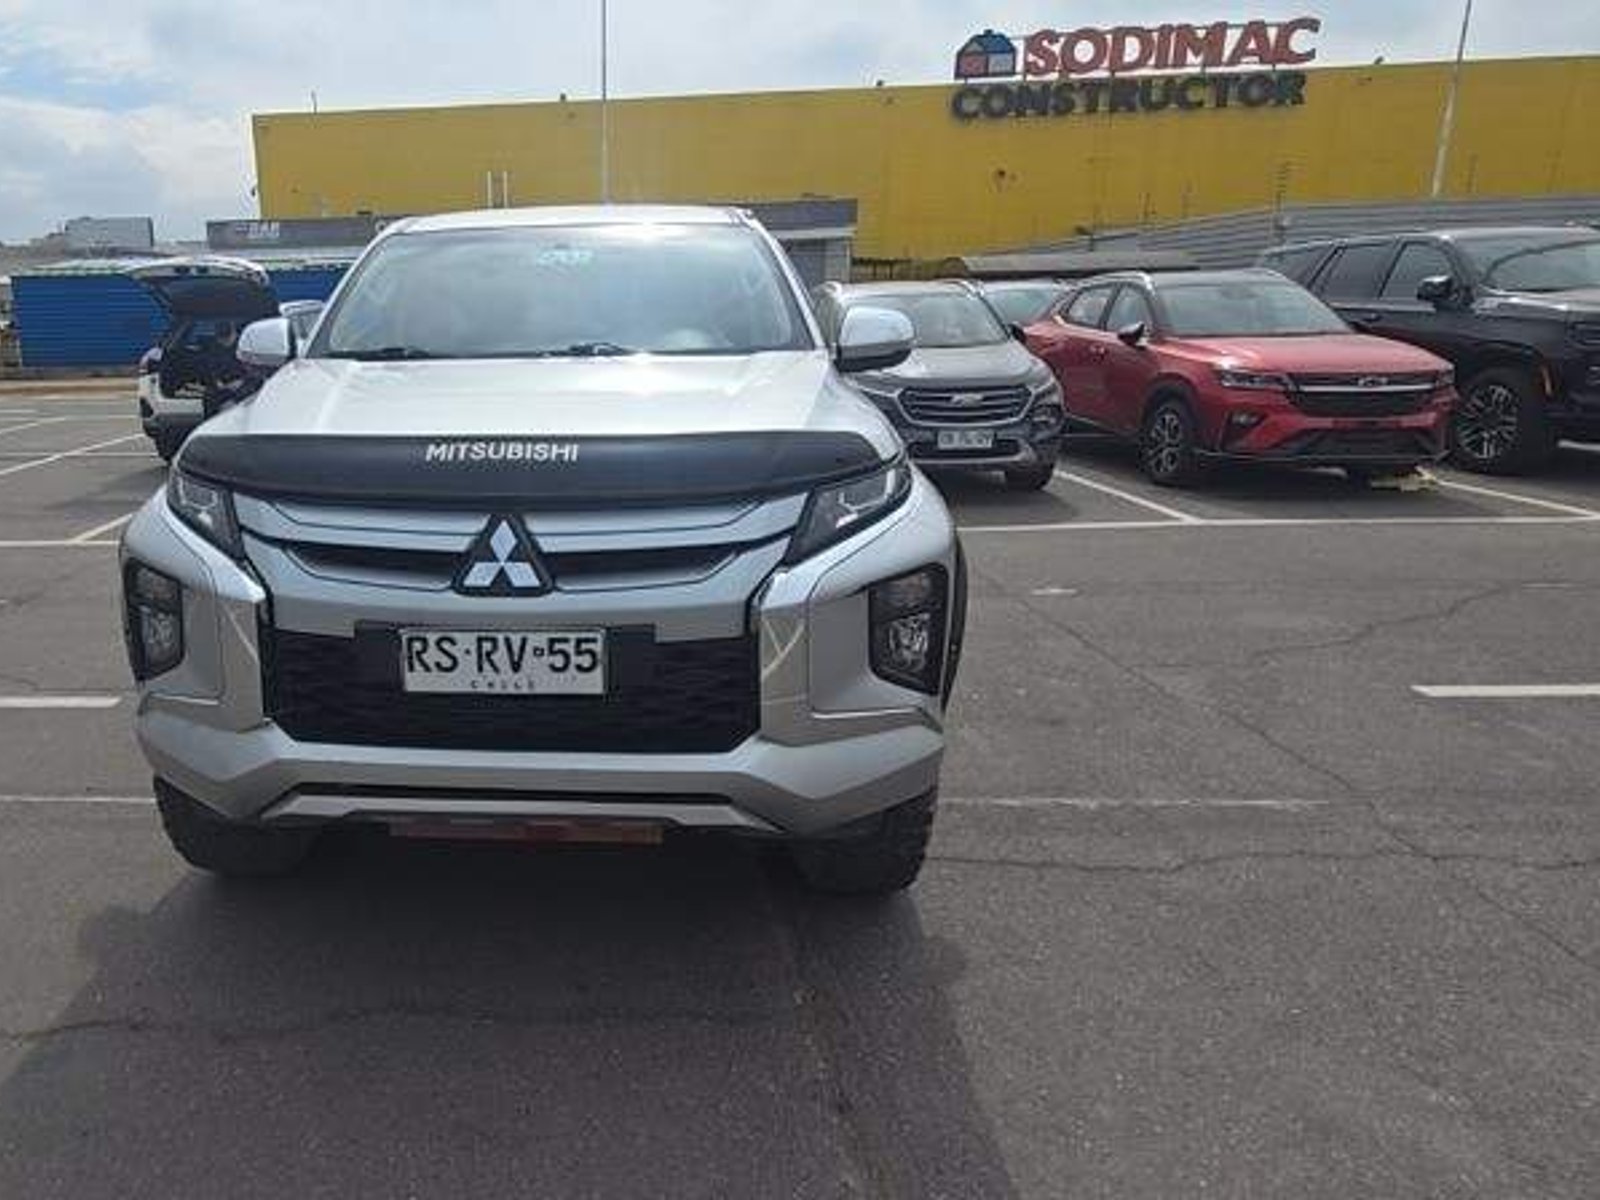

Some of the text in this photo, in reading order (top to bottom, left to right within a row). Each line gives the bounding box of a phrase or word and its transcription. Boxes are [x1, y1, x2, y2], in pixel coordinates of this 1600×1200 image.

[1024, 17, 1320, 77] SODIMAC
[952, 71, 1306, 119] CONSTRUCTOR
[425, 442, 580, 462] MITSUBISHI
